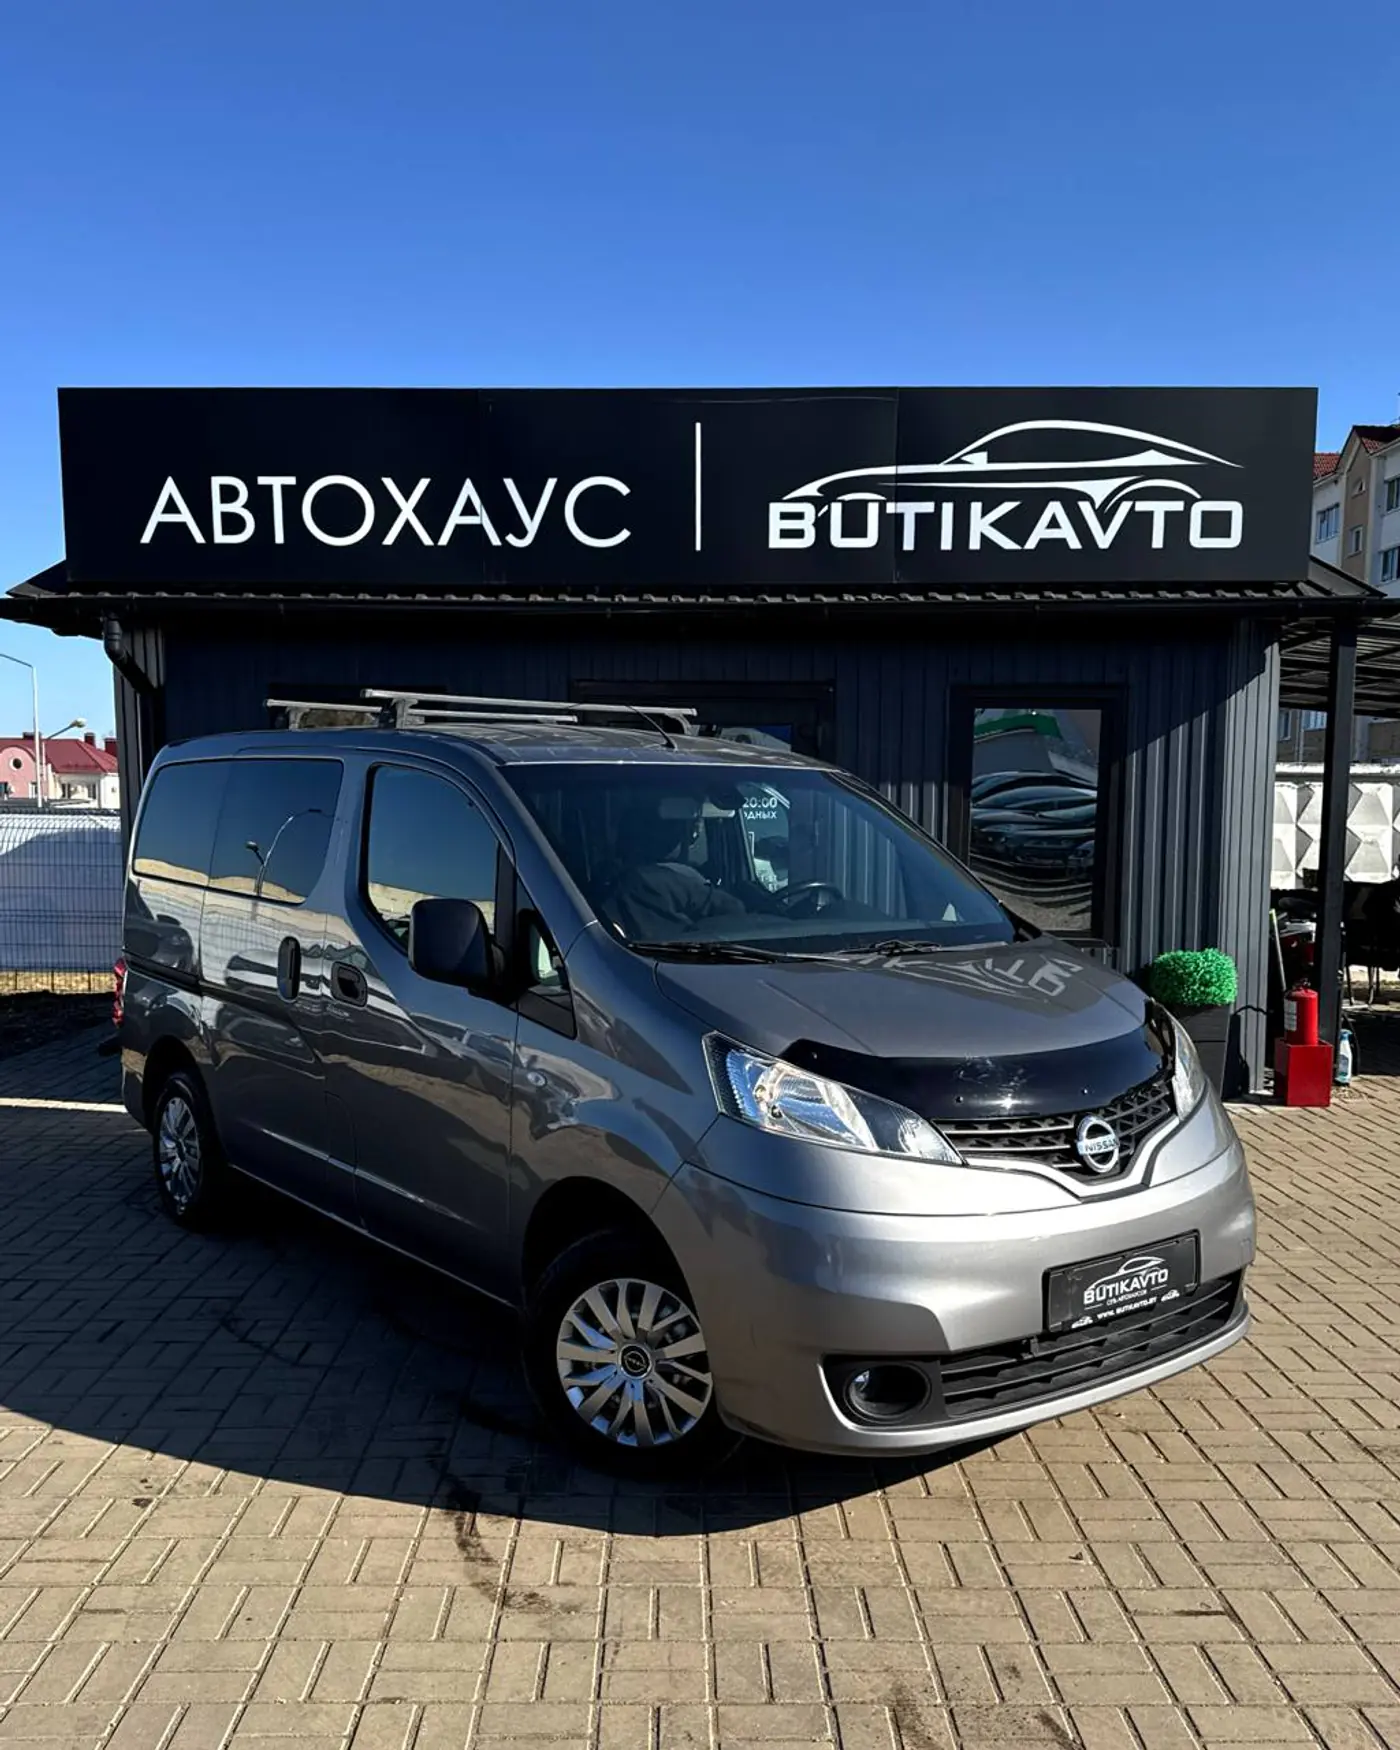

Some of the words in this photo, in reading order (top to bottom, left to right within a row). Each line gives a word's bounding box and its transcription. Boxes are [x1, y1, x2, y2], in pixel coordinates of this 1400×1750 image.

[141, 475, 631, 548] АВТОХАУС
[768, 501, 1243, 550] BUTIKAVTO
[742, 797, 778, 808] 20:00
[1083, 1269, 1169, 1305] BUTIKAVTO
